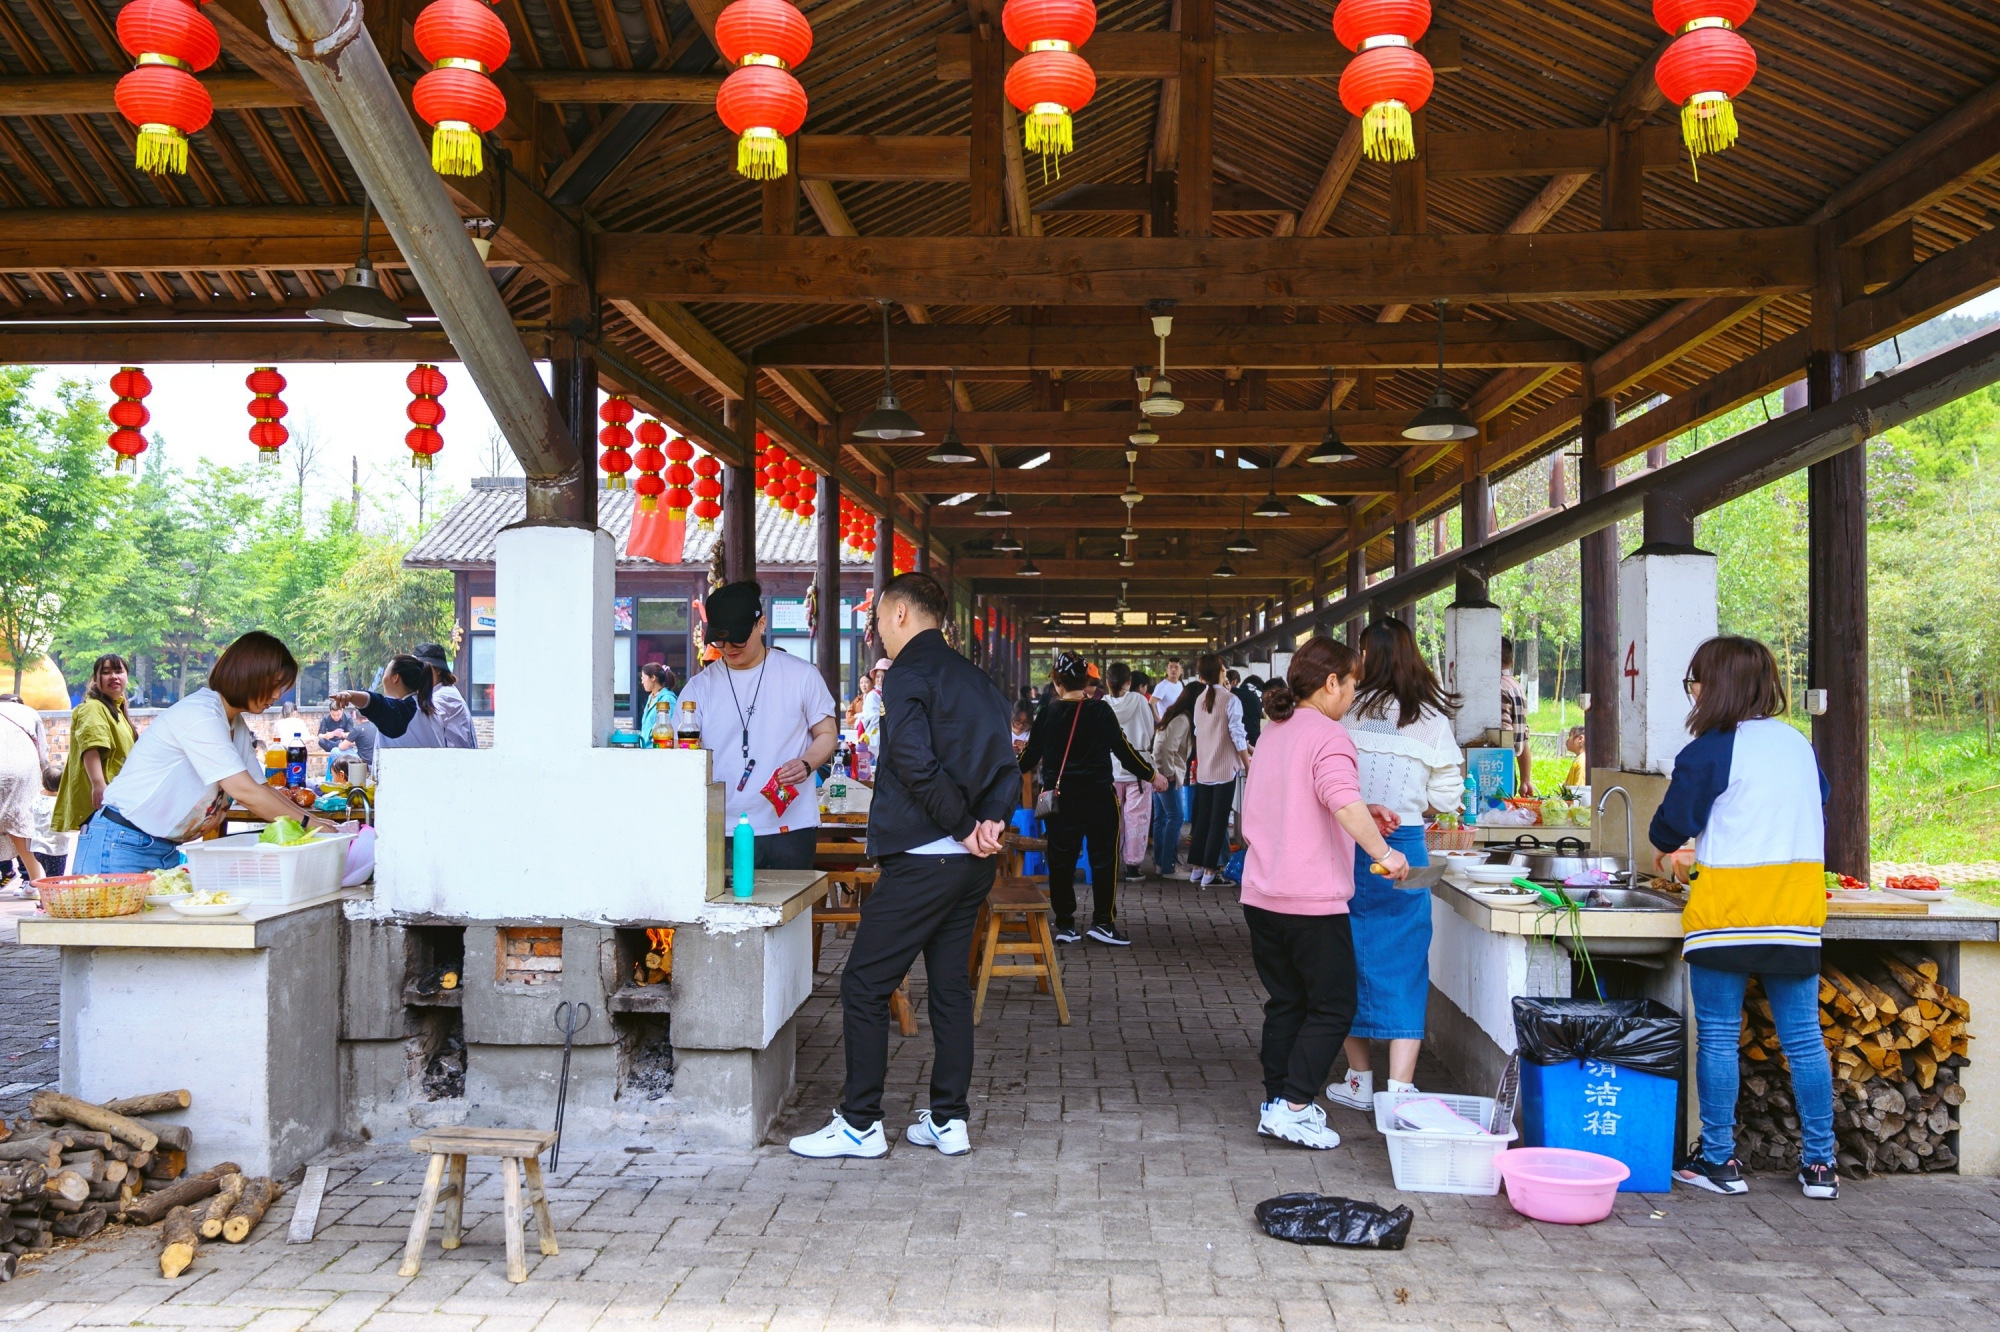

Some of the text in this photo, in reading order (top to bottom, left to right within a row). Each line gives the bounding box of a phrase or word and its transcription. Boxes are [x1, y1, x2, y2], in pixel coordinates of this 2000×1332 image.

[1624, 639, 1640, 701] 4
[1478, 759, 1504, 773] 节约
[1479, 774, 1504, 787] 用水
